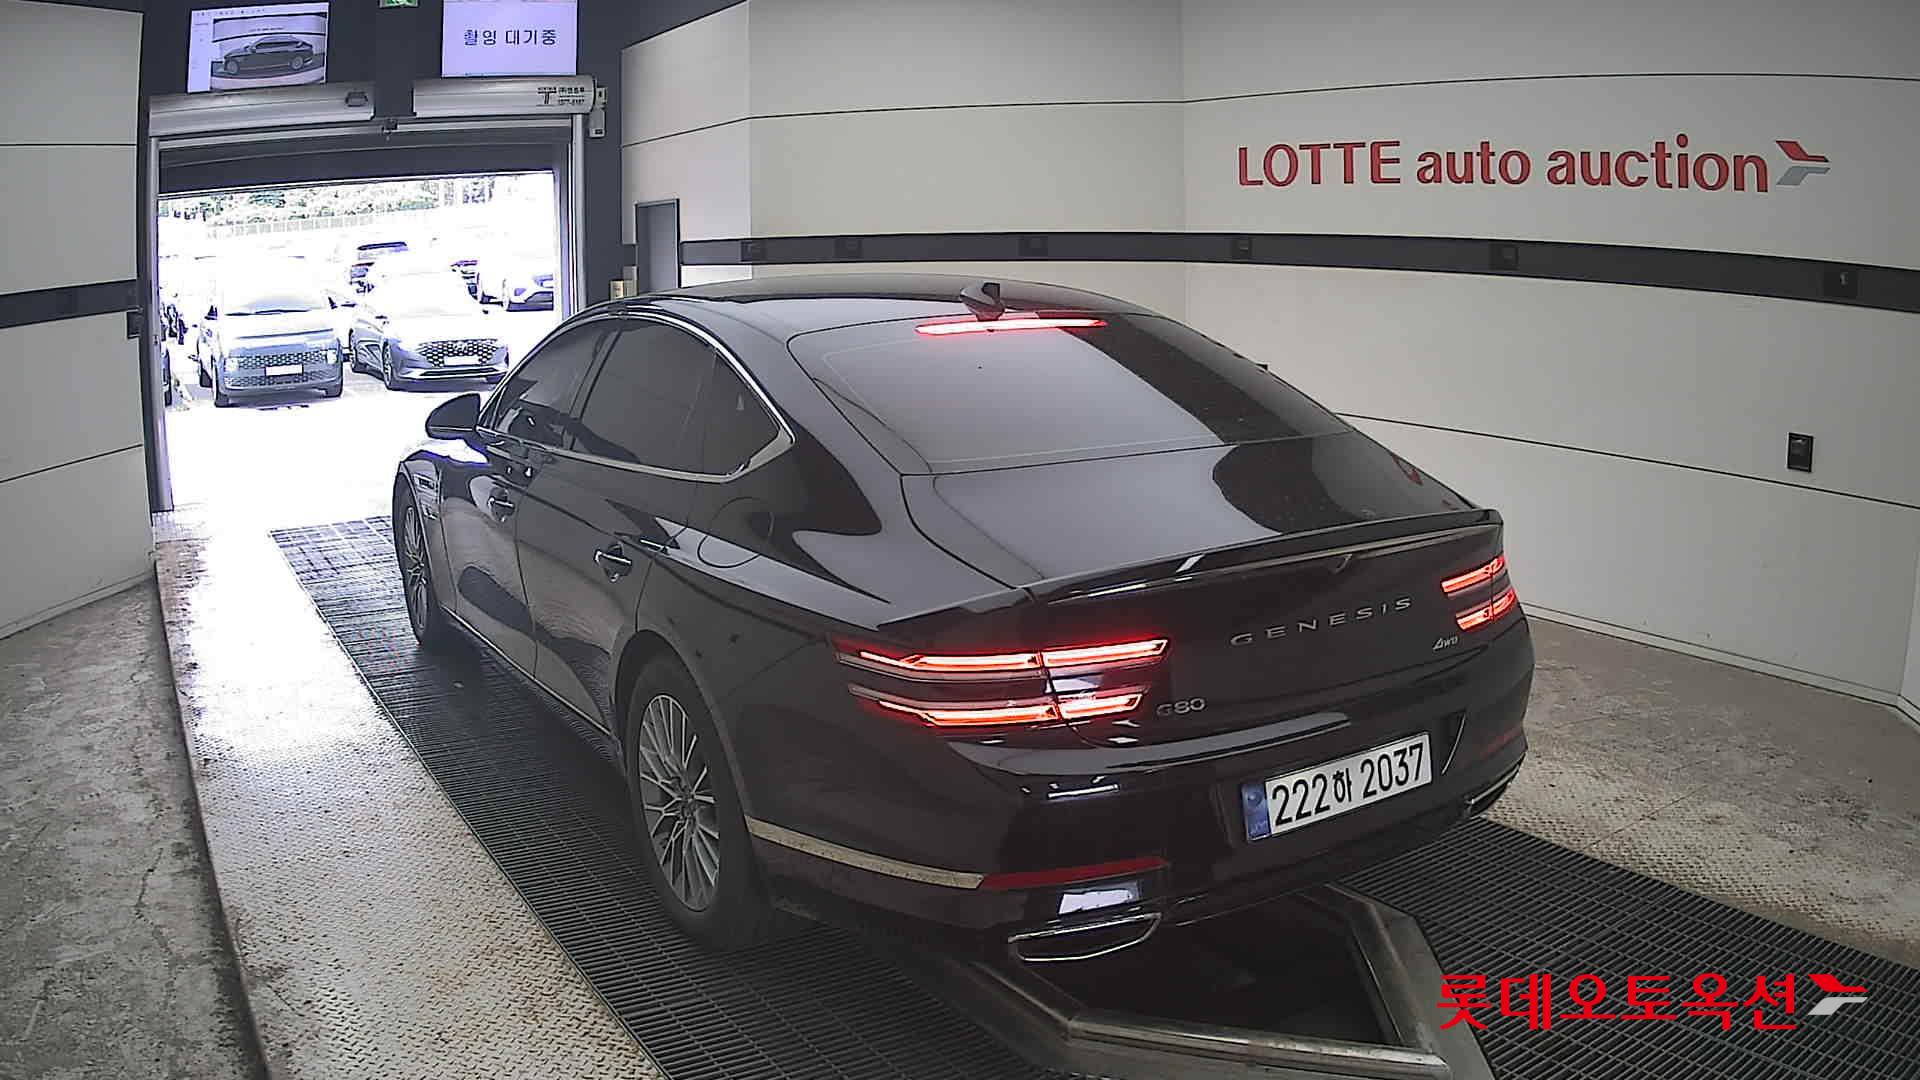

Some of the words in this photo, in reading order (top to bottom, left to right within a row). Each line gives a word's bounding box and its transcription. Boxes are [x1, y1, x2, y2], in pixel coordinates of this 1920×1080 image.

[505, 29, 556, 46] 대기중
[1238, 140, 1401, 187] LOTTE
[1416, 141, 1531, 185] auto
[1546, 133, 1769, 193] auction
[1230, 597, 1411, 645] GENESIS
[1156, 697, 1207, 716] G80
[1271, 767, 1352, 826] 222하
[1360, 742, 1424, 799] 2037
